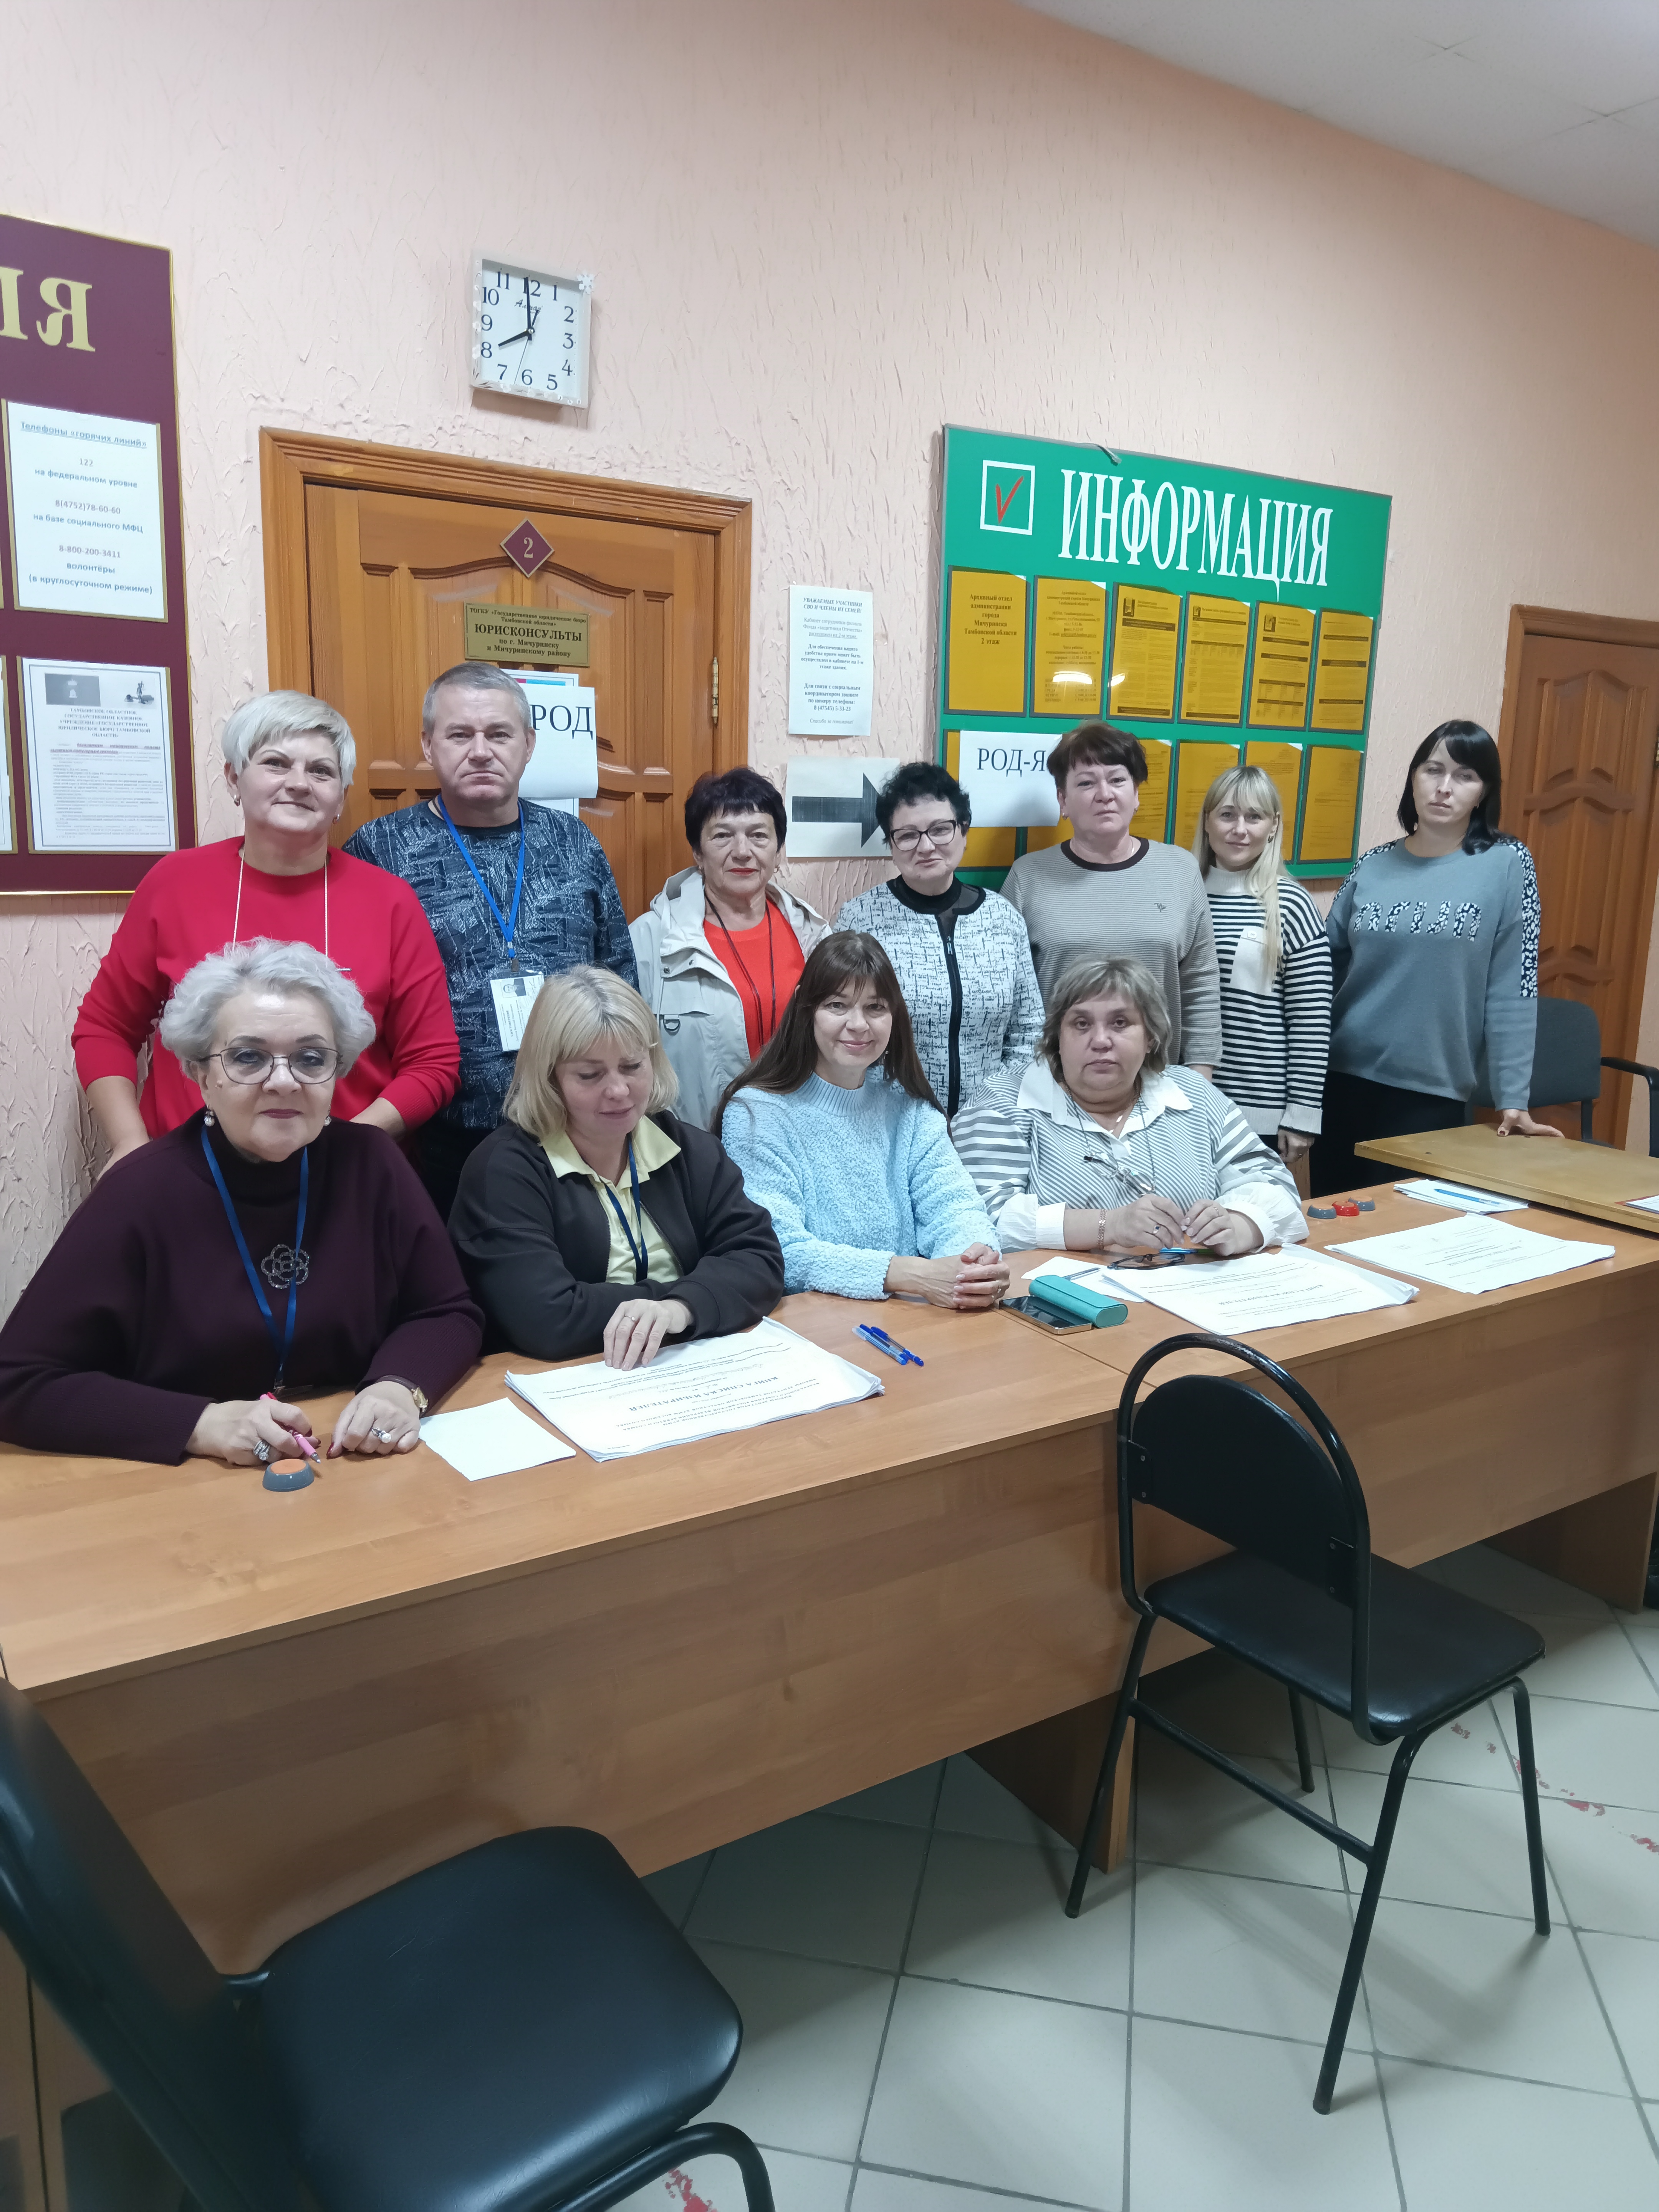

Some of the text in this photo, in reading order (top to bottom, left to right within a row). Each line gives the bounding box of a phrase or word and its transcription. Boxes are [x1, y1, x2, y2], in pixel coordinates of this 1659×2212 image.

[483, 287, 499, 306] 10
[564, 306, 574, 323] 2
[481, 315, 492, 331] 9
[563, 333, 574, 349] 3
[481, 342, 492, 358] 8
[497, 364, 507, 380] 7
[562, 359, 573, 376] 4
[522, 369, 533, 385] 6
[547, 374, 558, 390] 5
[21, 422, 147, 447] Телефоны «горячих линий»
[79, 458, 93, 467] 122
[48, 470, 106, 484] федеральном
[109, 479, 137, 488] уровне
[46, 514, 64, 523] базе
[67, 518, 120, 530] социального
[123, 524, 143, 533] МФЦ
[1058, 469, 1333, 603] ИНФОРМАЦИЯ
[524, 537, 533, 558] 2
[40, 576, 111, 589] круглосуточном
[114, 584, 152, 595] режиме)
[492, 609, 537, 619] «Государственное
[501, 617, 532, 625] Тамбовской
[475, 624, 581, 642] ЮРИСКОНСУЛЬТЫ
[494, 645, 545, 656] Мичуринскому
[548, 649, 571, 658] району
[518, 639, 559, 649] Мичуринску
[530, 704, 593, 740] РОД
[977, 748, 1046, 778] РОД-Я
[745, 1377, 778, 1386] КНИГА
[703, 1385, 743, 1396] СПИСКА
[629, 1394, 701, 1411] ИЗБИРАТЕЛЕЙ
